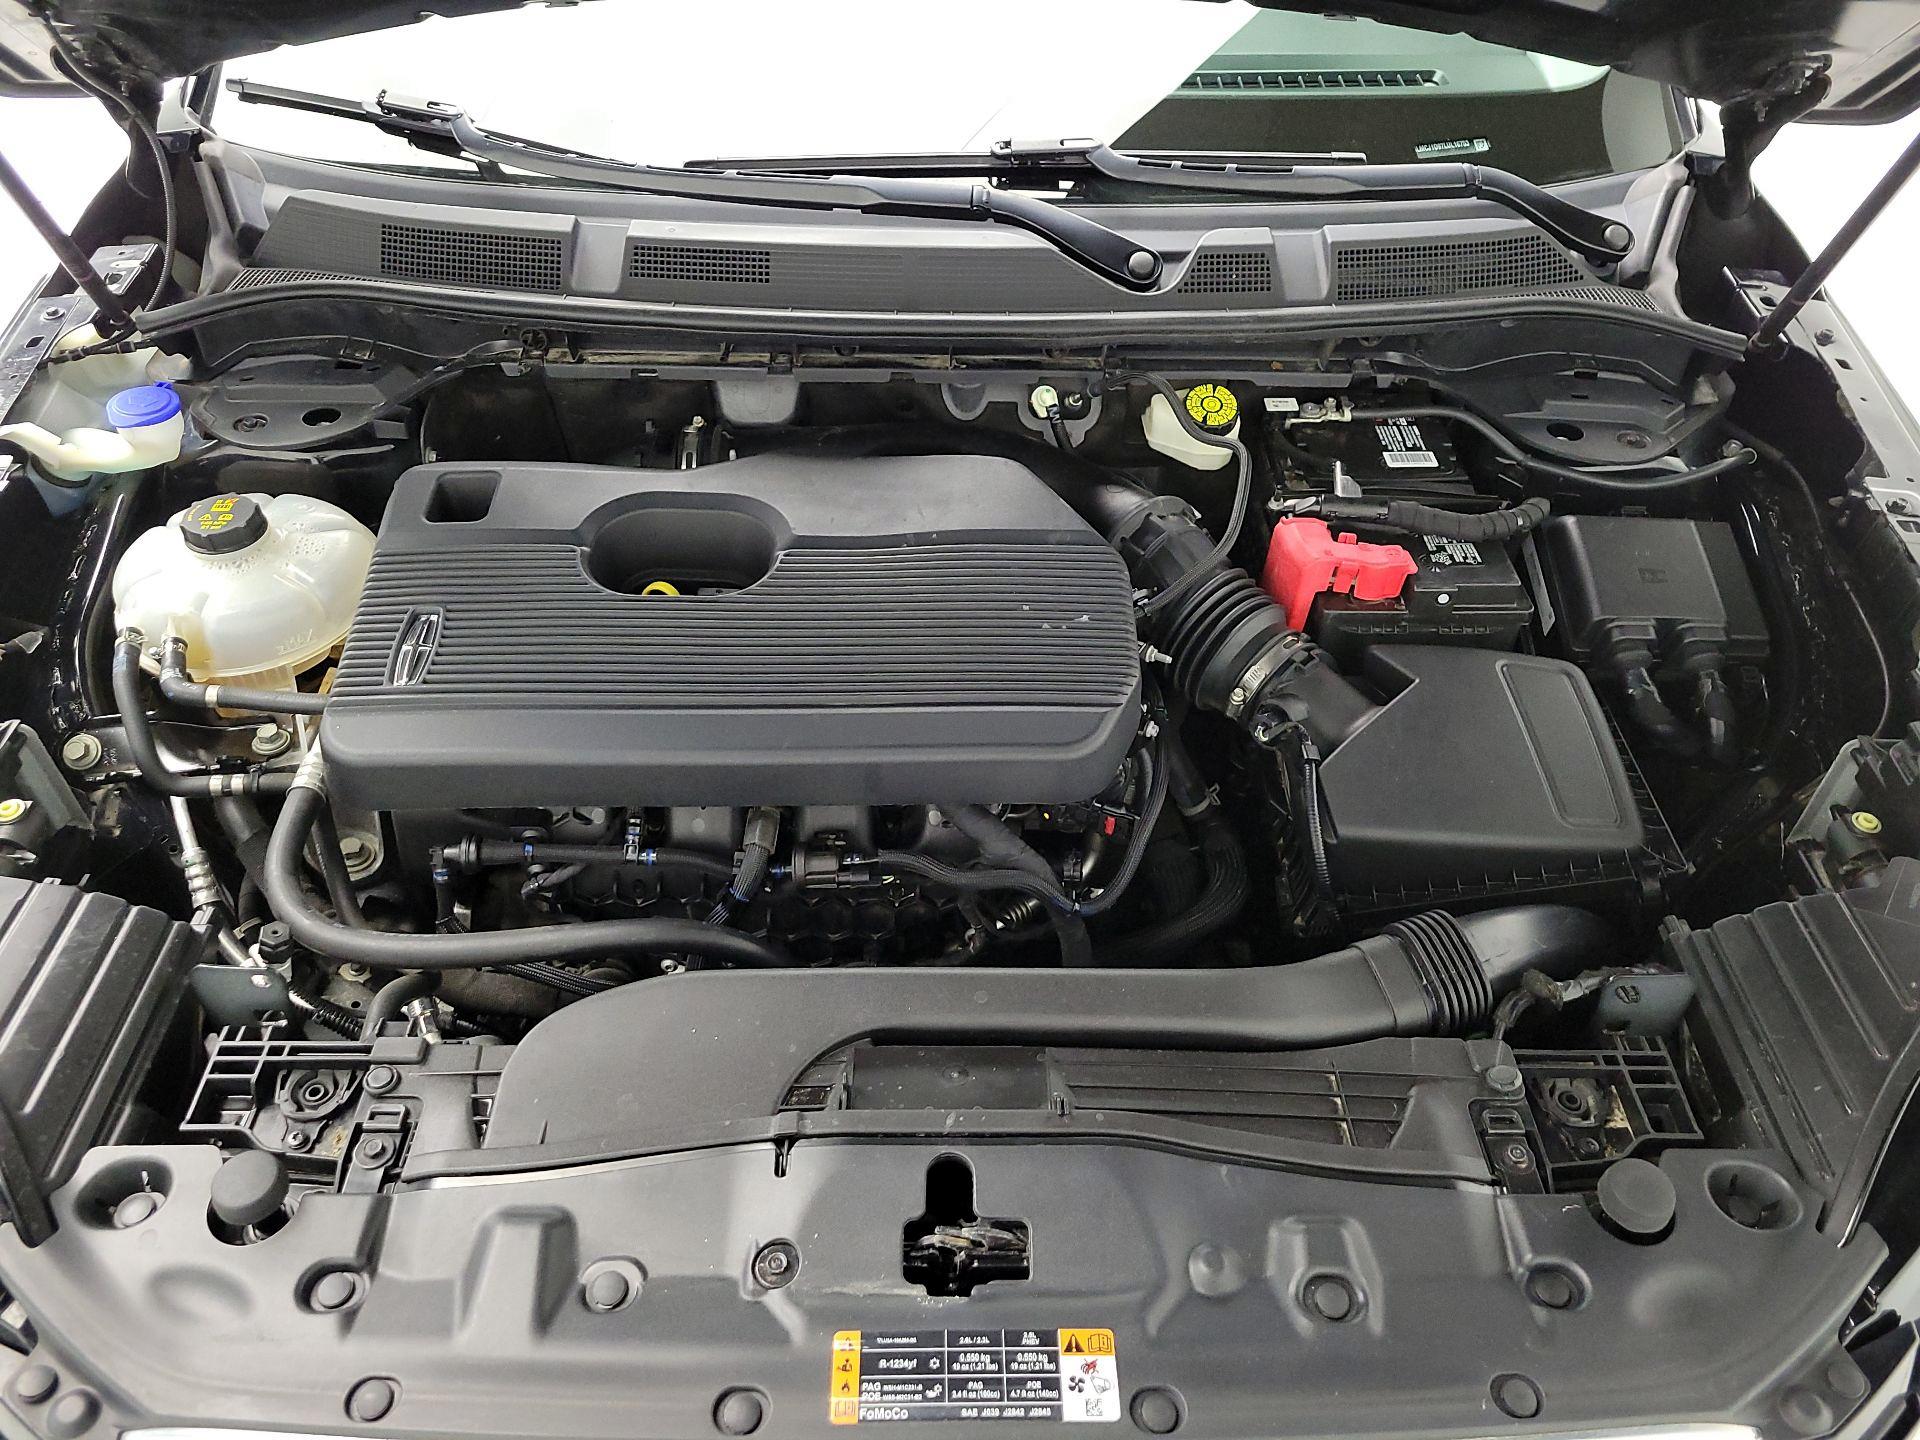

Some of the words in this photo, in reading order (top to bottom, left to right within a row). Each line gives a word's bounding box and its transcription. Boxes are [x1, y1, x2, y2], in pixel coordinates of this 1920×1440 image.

[980, 1353, 990, 1363] kg
[1038, 1352, 1048, 1362] kg
[879, 1359, 917, 1369] R-1234yf
[862, 1382, 881, 1391] PAG
[968, 1381, 983, 1389] PAG
[860, 1407, 908, 1420] FoMoCo
[961, 1408, 978, 1417] SAE
